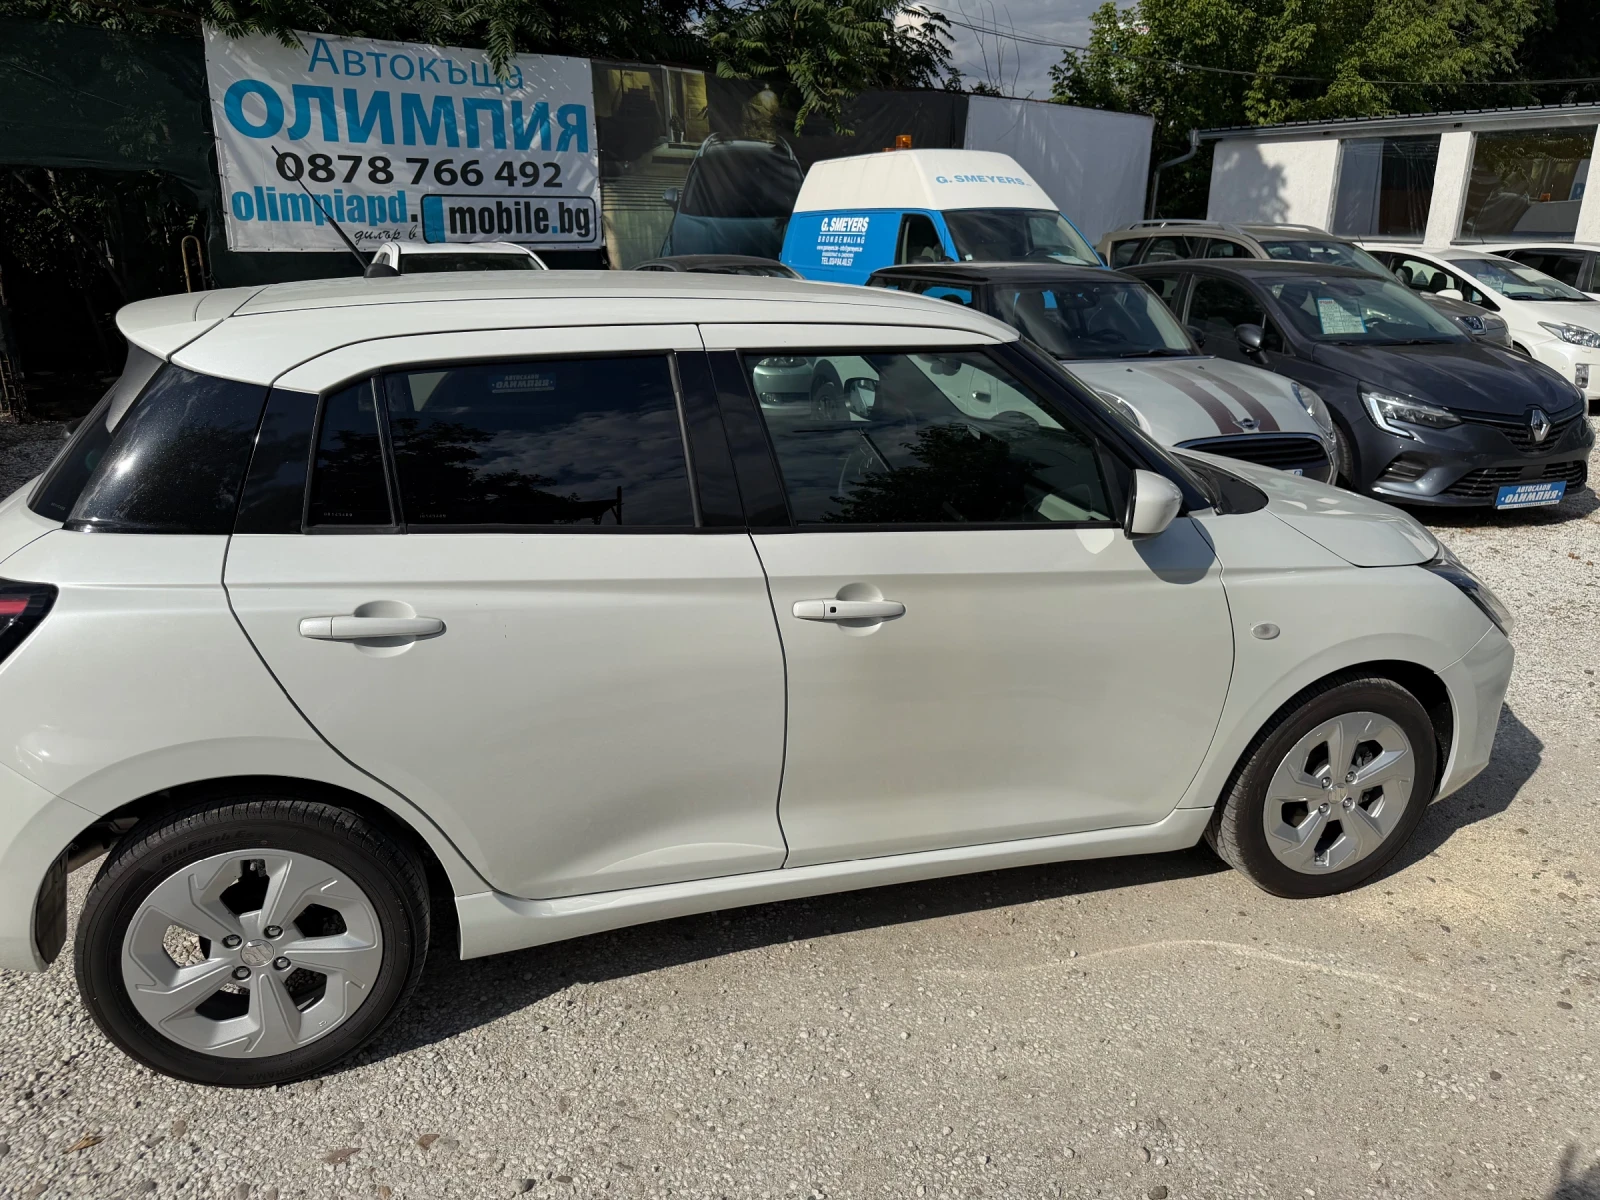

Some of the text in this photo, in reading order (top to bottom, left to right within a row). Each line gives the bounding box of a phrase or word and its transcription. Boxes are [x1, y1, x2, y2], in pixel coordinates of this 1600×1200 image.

[309, 38, 523, 94] Автокъща
[224, 79, 589, 152] ОЛИМПИЯ
[276, 152, 564, 188] 0878 766 492
[936, 175, 1026, 186] G. SMEYERS
[449, 202, 590, 238] mobile.bg
[821, 217, 869, 232] G. SMEYERS
[354, 227, 402, 246] дилър
[1505, 490, 1558, 503] ОЛИМПИЯ
[1516, 484, 1551, 493] АВТОСАЛОН
